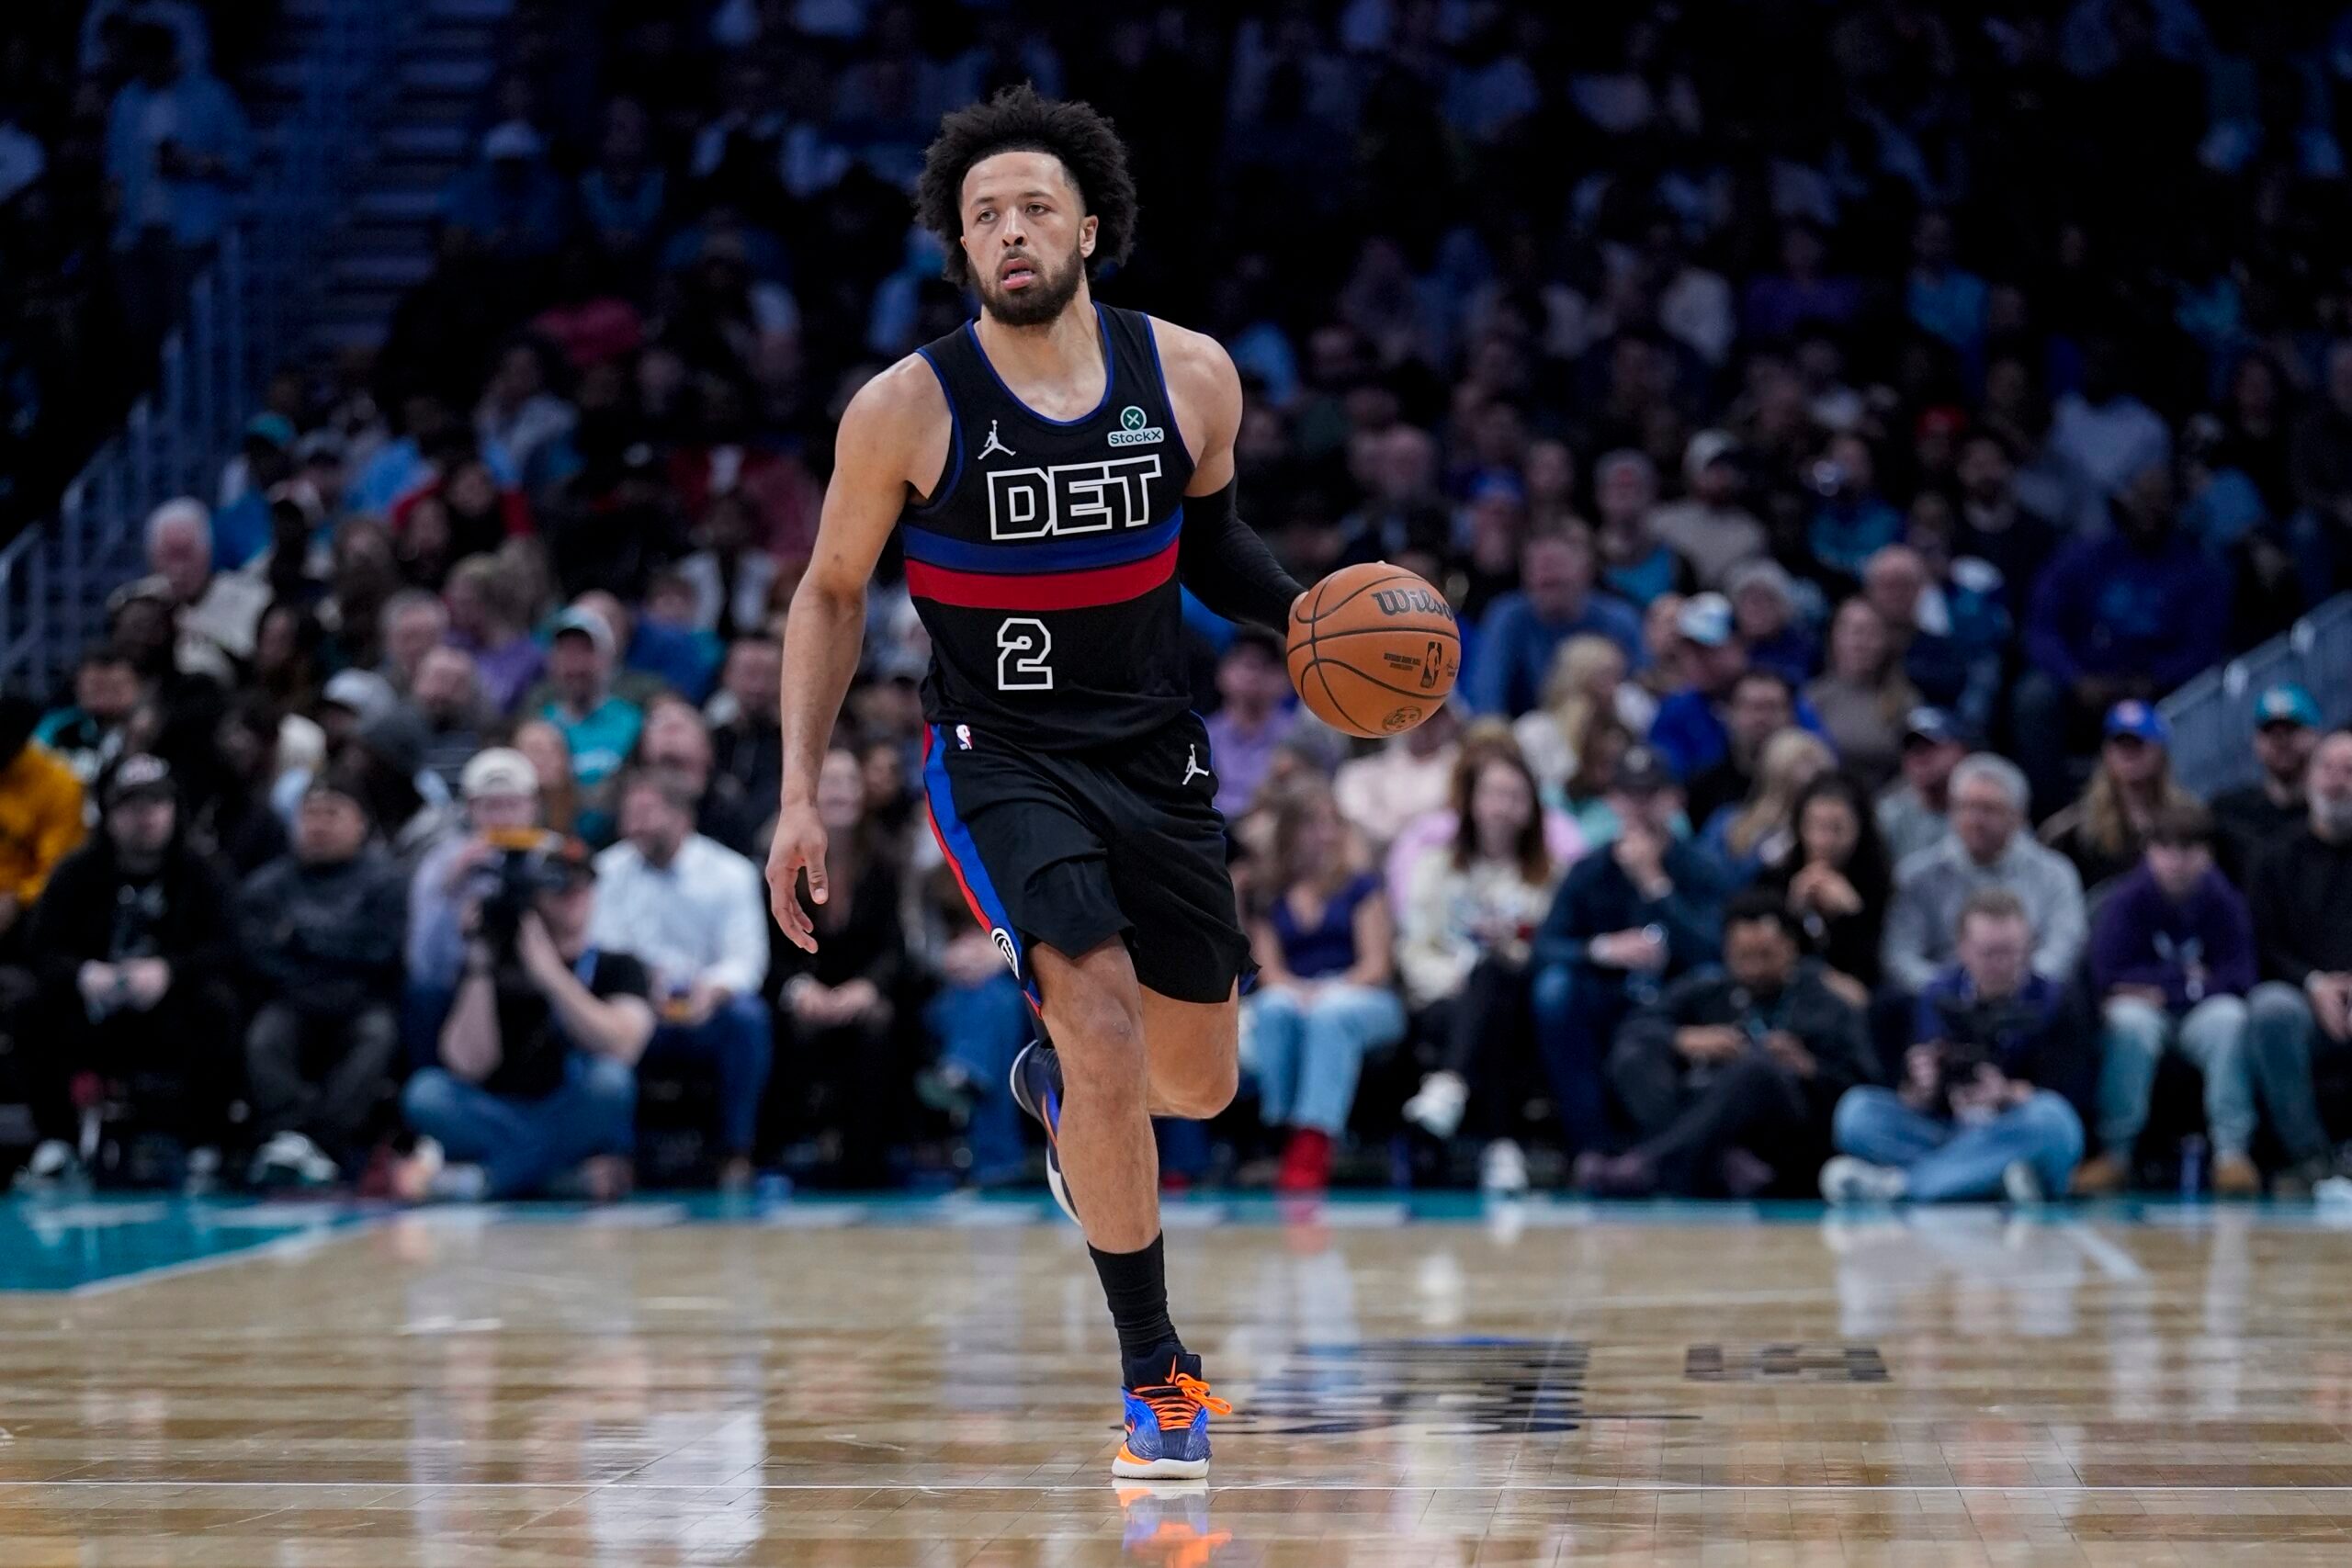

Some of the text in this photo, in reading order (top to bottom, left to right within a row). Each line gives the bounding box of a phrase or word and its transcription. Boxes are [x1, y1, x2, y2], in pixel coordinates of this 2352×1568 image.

[1126, 412, 1140, 426] X
[1110, 430, 1162, 445] StockX
[987, 454, 1162, 540] DET
[1371, 588, 1454, 621] Wilso
[997, 618, 1053, 690] 2
